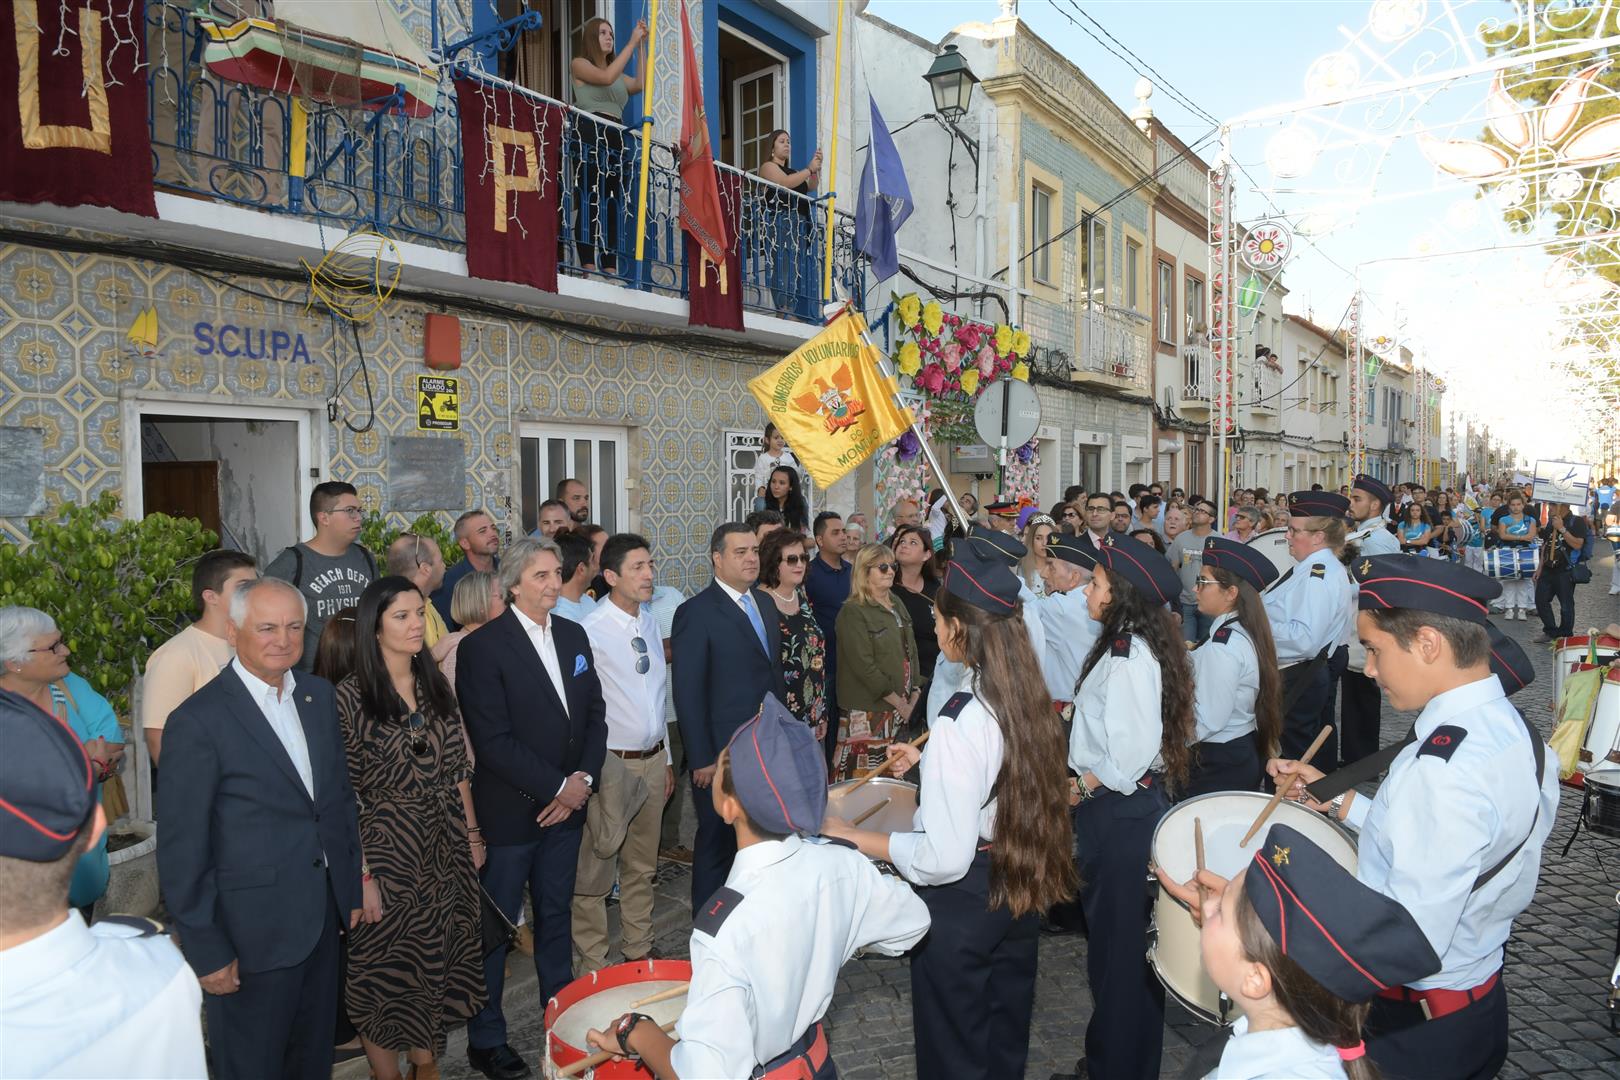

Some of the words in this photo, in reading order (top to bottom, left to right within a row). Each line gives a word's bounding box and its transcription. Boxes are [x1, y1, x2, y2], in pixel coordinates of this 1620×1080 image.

[488, 124, 541, 233] P
[193, 322, 316, 364] S.C.U.P.A.
[771, 361, 804, 413] BOMBEIROS
[850, 429, 864, 441] DO
[309, 567, 344, 594] BEACH
[346, 567, 370, 588] DEPT
[337, 584, 352, 594] 1971
